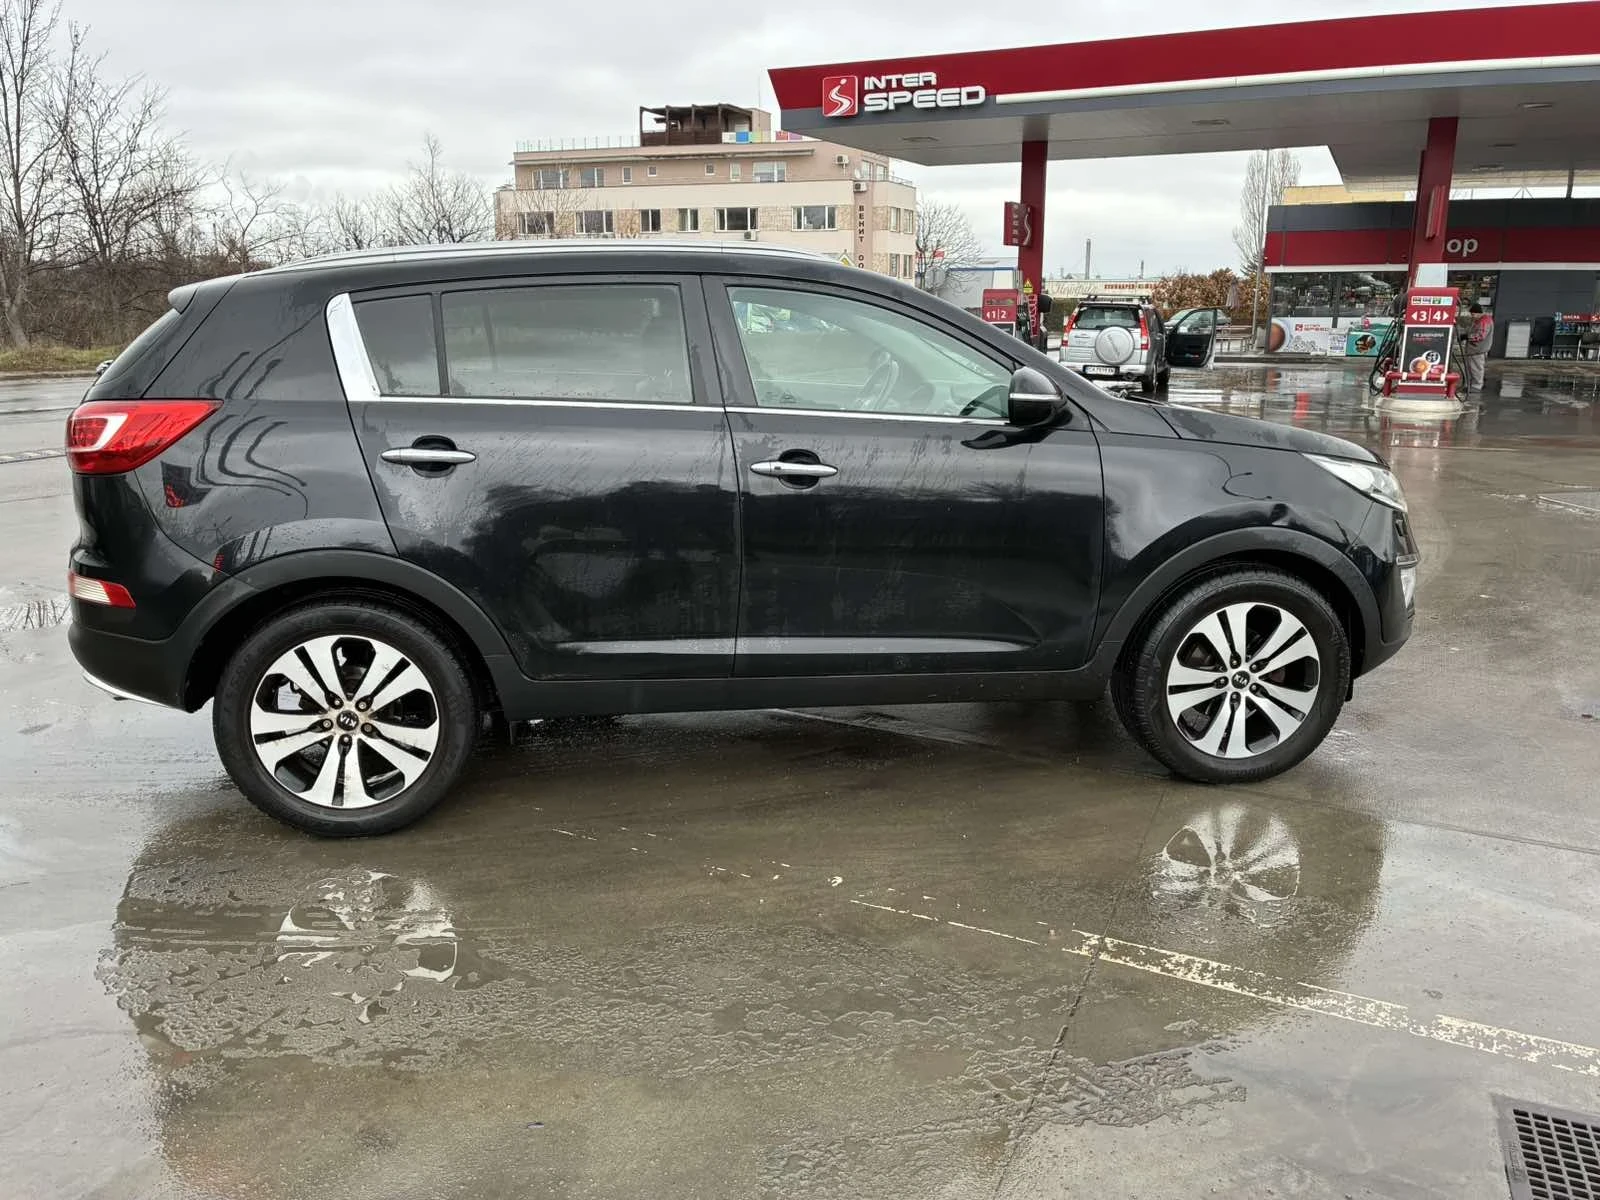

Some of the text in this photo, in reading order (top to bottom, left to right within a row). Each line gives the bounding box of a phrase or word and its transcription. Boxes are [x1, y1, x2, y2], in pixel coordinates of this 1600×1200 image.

[864, 71, 937, 91] INTER
[864, 85, 986, 112] SPEED
[1000, 310, 1007, 319] 2
[1419, 310, 1441, 321] 3 4
